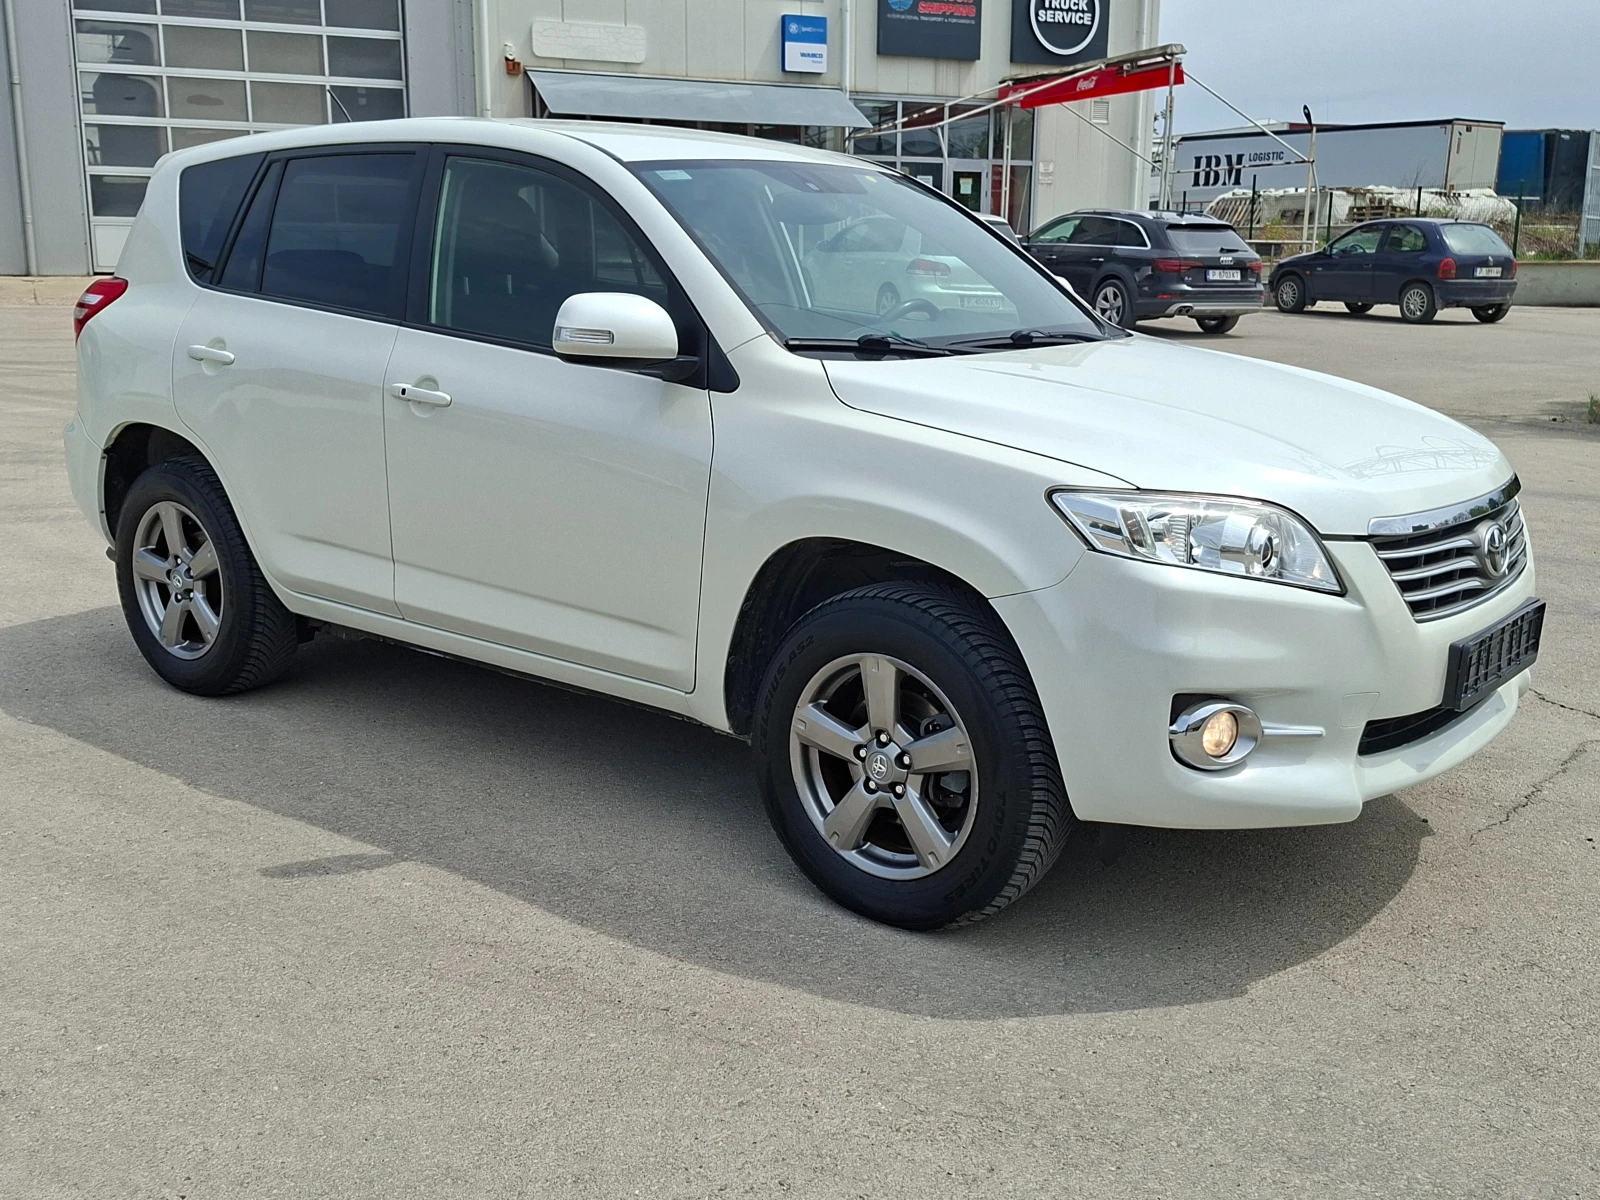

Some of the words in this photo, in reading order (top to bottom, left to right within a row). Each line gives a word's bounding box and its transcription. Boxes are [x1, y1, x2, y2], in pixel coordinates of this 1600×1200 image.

[918, 1, 976, 17] SHIPPING
[1044, 0, 1088, 11] TRUCK
[1037, 9, 1092, 25] SERVICE
[1191, 153, 1245, 187] IBM
[1248, 151, 1285, 162] LOGISTIC
